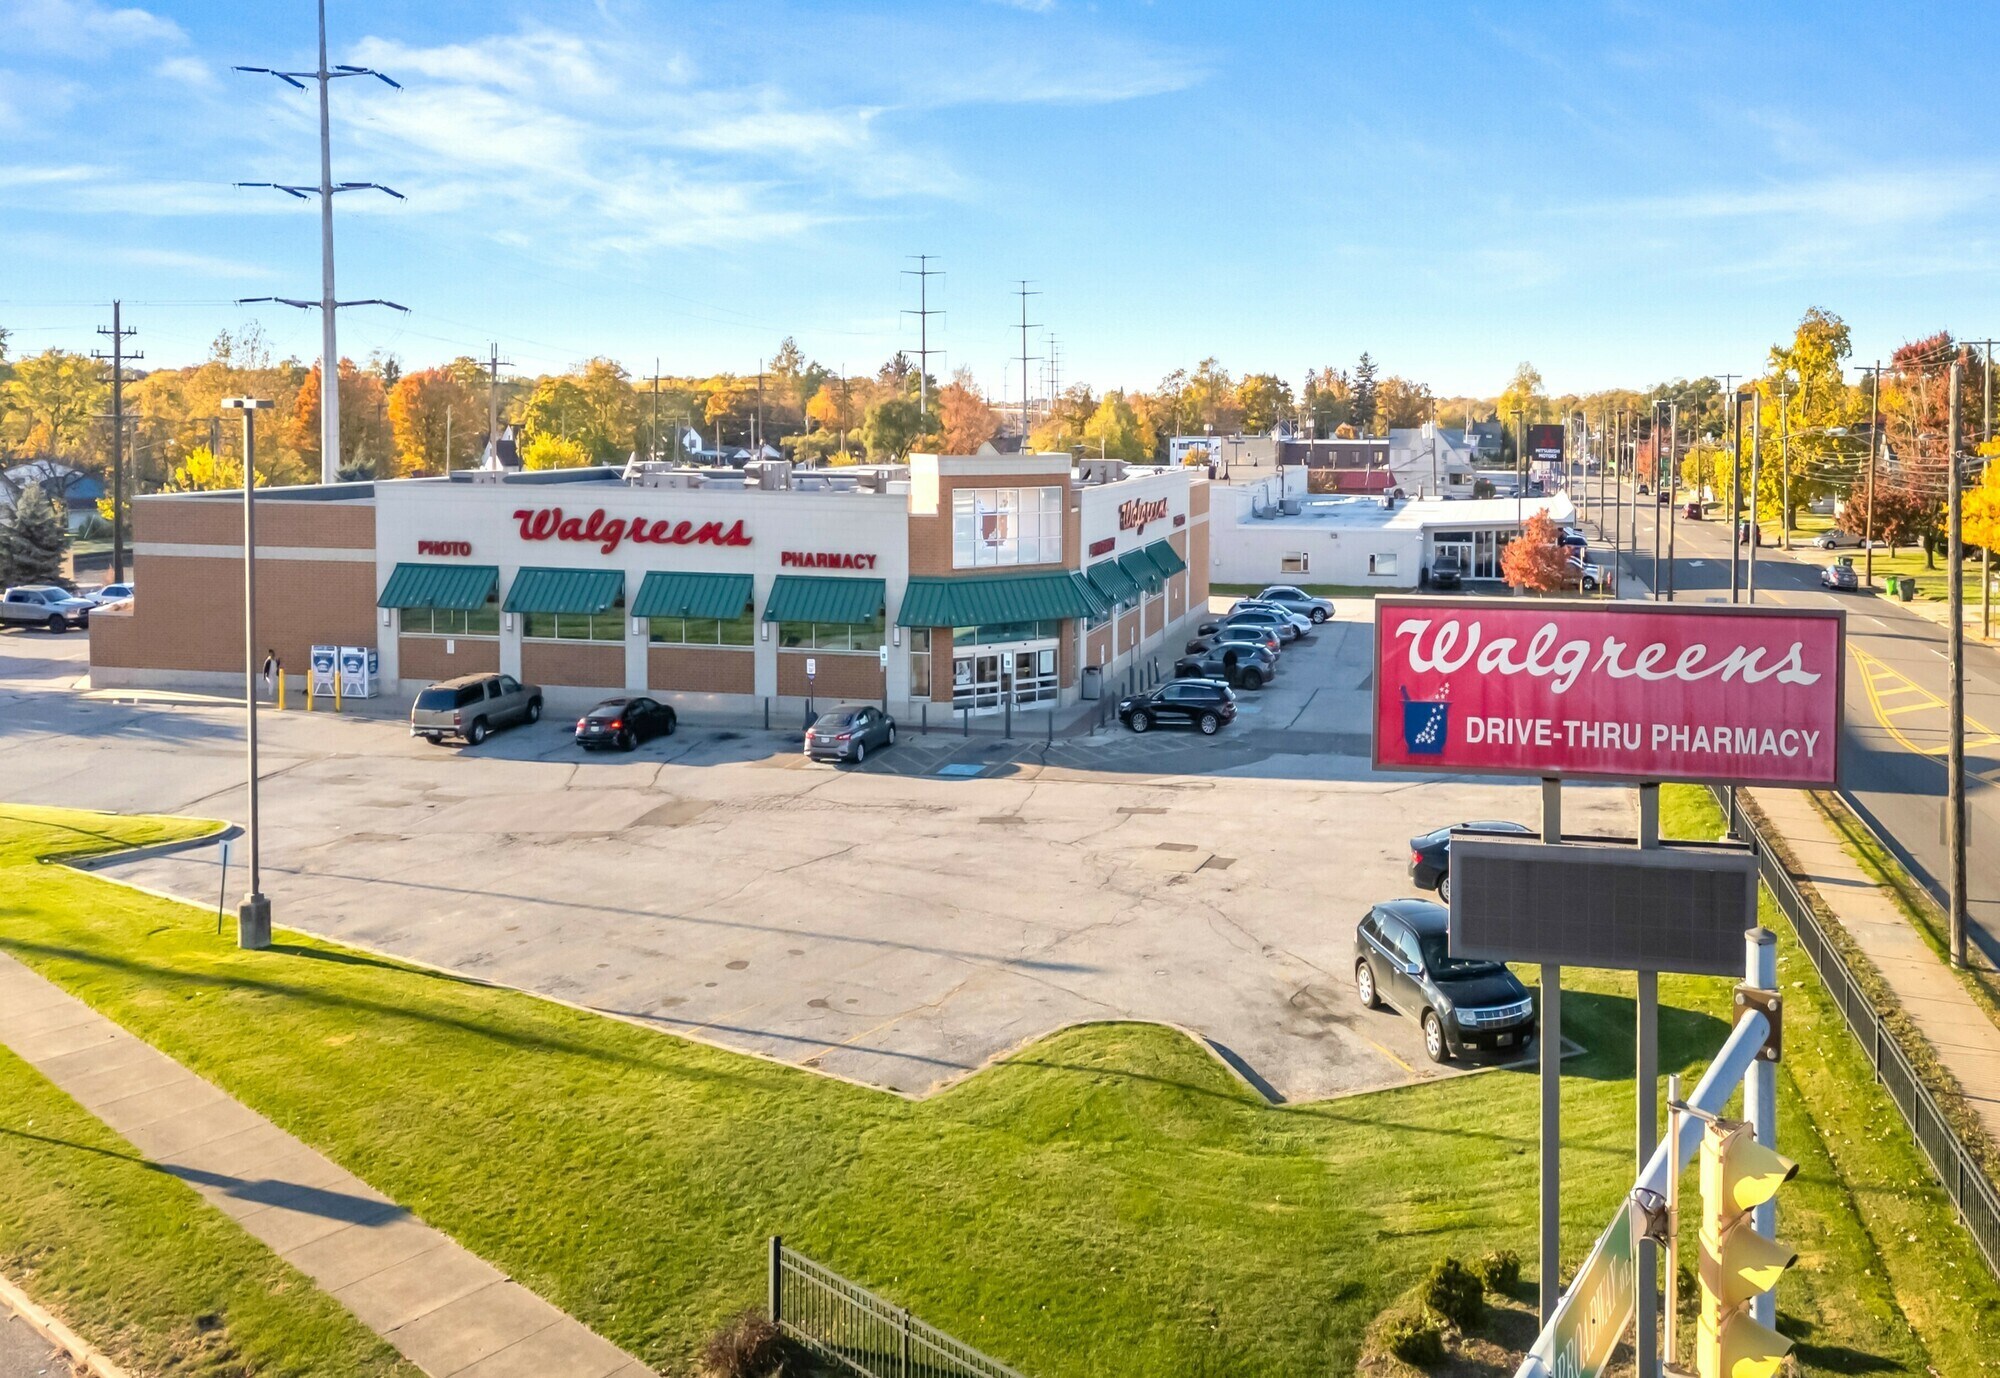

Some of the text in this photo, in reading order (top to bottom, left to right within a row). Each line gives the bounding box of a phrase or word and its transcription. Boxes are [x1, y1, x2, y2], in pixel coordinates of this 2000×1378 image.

[418, 540, 472, 557] PHOTO
[513, 507, 753, 555] Walgreens
[781, 551, 877, 570] PHARMACY
[1395, 618, 1822, 695] Walgreens
[1465, 716, 1821, 758] DRIVE-THRU PHARMACY
